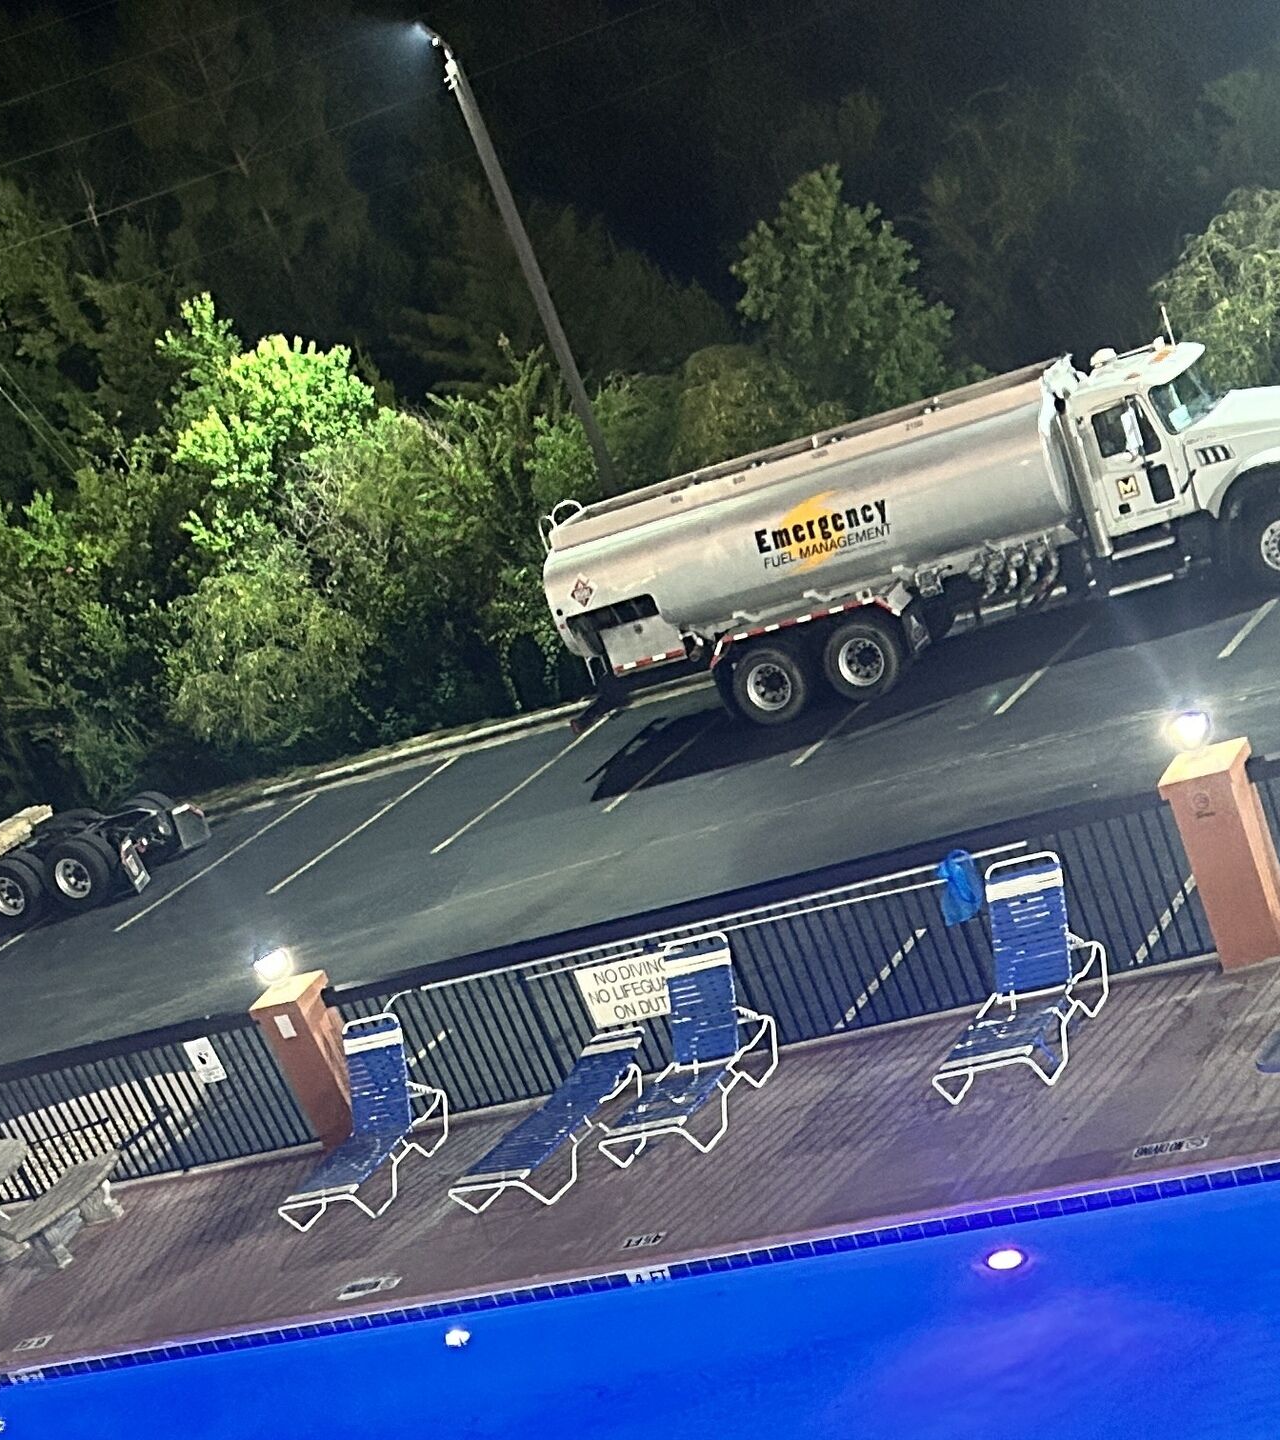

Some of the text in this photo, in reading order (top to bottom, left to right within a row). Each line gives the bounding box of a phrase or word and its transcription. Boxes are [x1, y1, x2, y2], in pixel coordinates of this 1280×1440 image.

[1117, 476, 1139, 497] M
[754, 499, 887, 554] Emergency
[763, 551, 797, 570] FUEL
[798, 522, 892, 560] MANAGEMENT
[593, 968, 618, 986] NO
[588, 976, 666, 1006] NO LIFEGUA
[613, 995, 667, 1020] ON DUT
